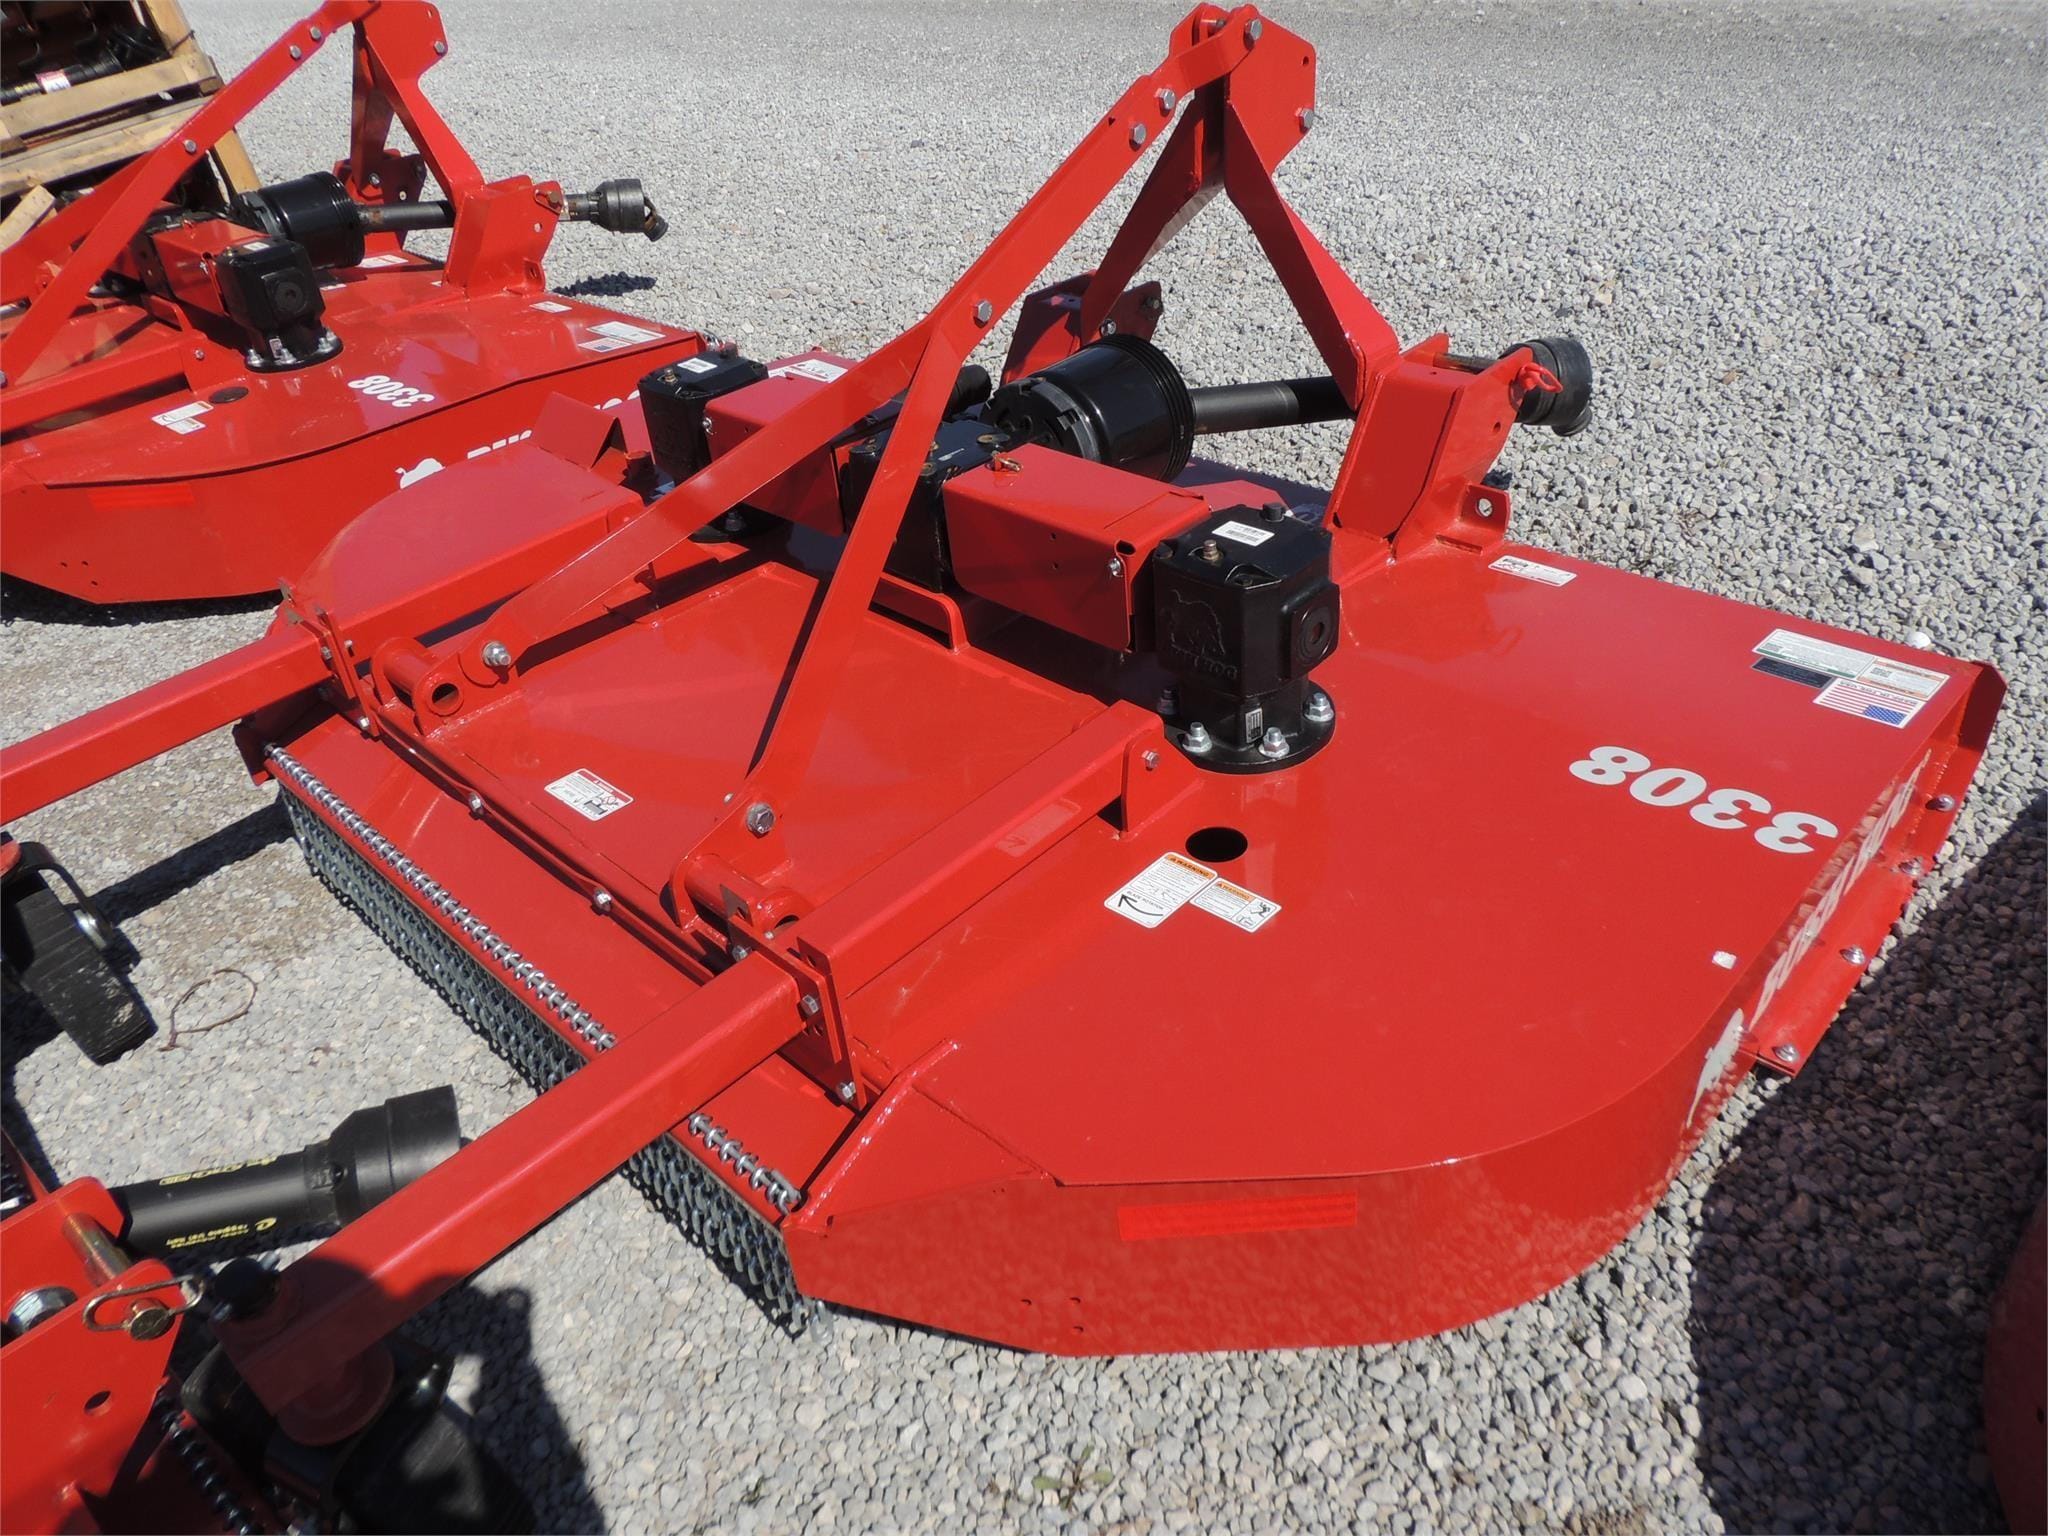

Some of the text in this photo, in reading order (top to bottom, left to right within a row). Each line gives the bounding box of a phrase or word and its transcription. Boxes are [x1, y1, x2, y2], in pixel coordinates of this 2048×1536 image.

[347, 375, 435, 408] 3308
[1568, 745, 1839, 854] 3308
[1176, 859, 1211, 878] WARNING
